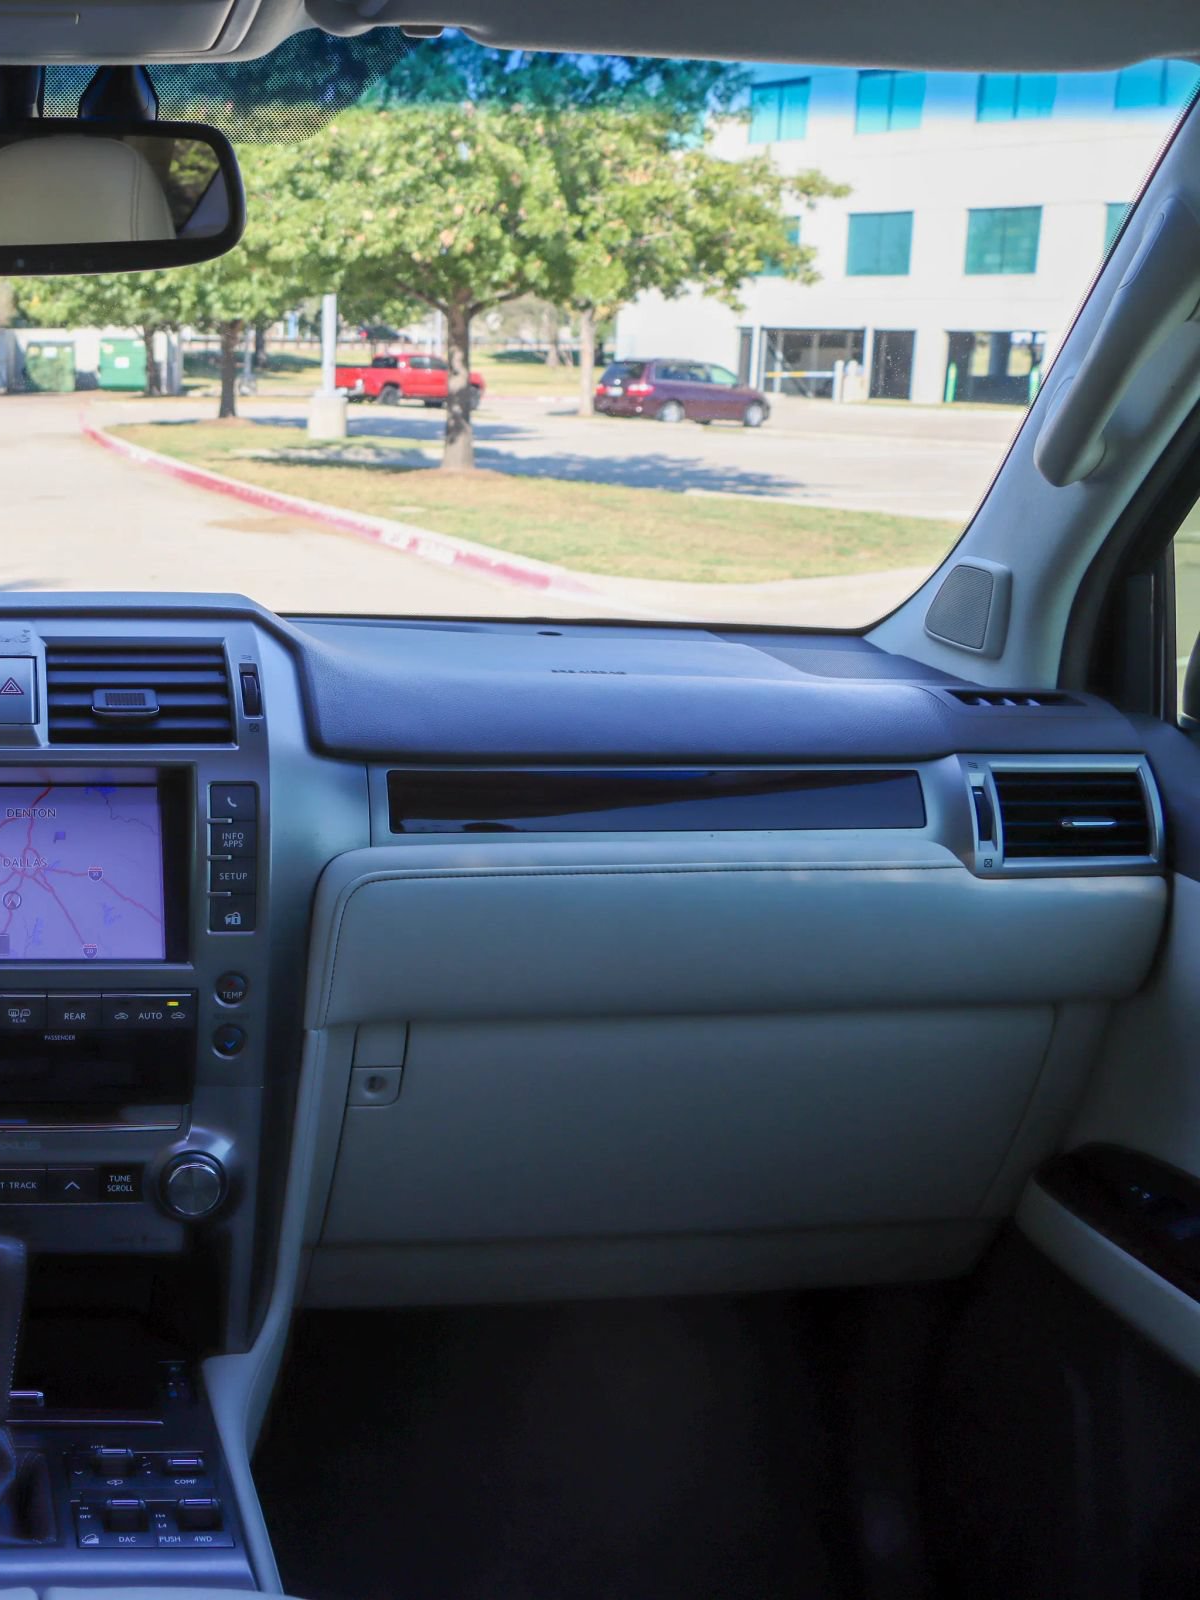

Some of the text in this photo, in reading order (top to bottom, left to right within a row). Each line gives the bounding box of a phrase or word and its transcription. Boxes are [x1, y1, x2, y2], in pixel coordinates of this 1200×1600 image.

[6, 808, 56, 818] DENTON
[222, 832, 244, 840] INFO
[223, 839, 243, 848] APPS
[3, 858, 48, 868] DALLAS
[218, 872, 248, 880] SETUP
[222, 991, 243, 999] TEMP
[64, 1012, 86, 1020] REAR
[138, 1012, 163, 1020] AUTO
[109, 1175, 132, 1183] TUNE
[9, 1182, 37, 1190] TRACK
